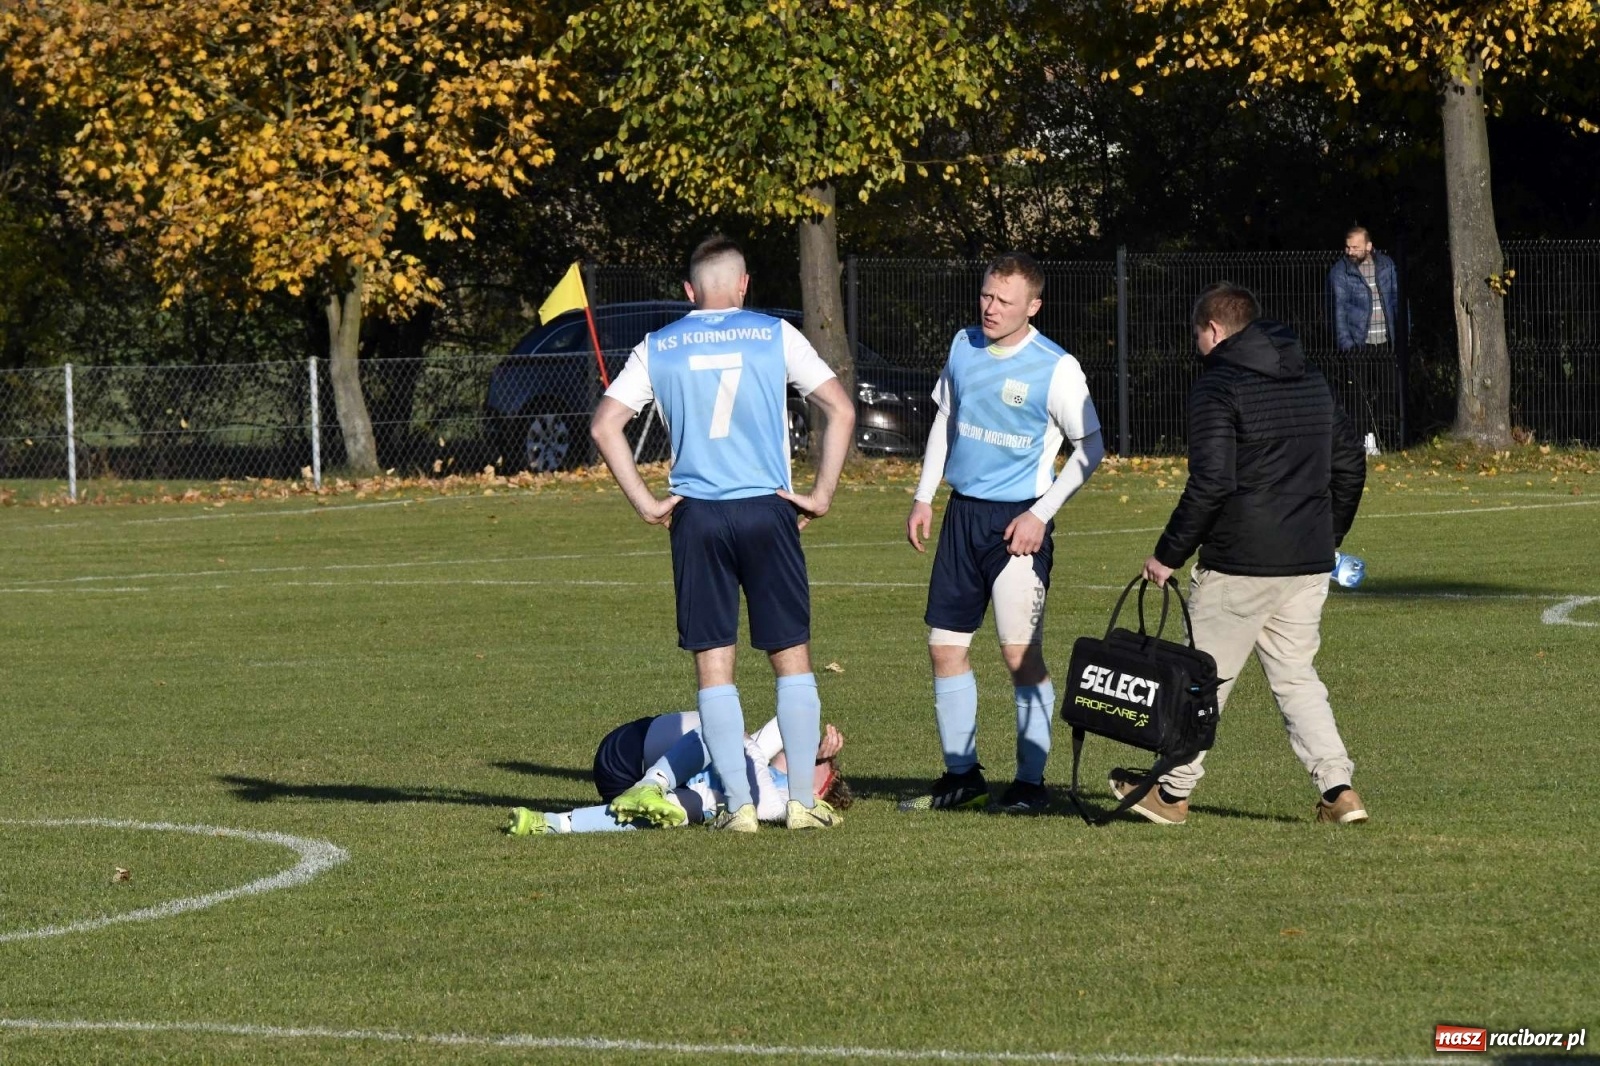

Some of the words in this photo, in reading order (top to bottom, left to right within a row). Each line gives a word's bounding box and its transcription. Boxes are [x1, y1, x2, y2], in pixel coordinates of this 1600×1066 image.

[657, 336, 677, 352] KS
[683, 328, 772, 345] KORNOWAC
[689, 352, 743, 439] 7
[1079, 664, 1160, 707] SELECT
[1075, 696, 1138, 721] PROFCARE
